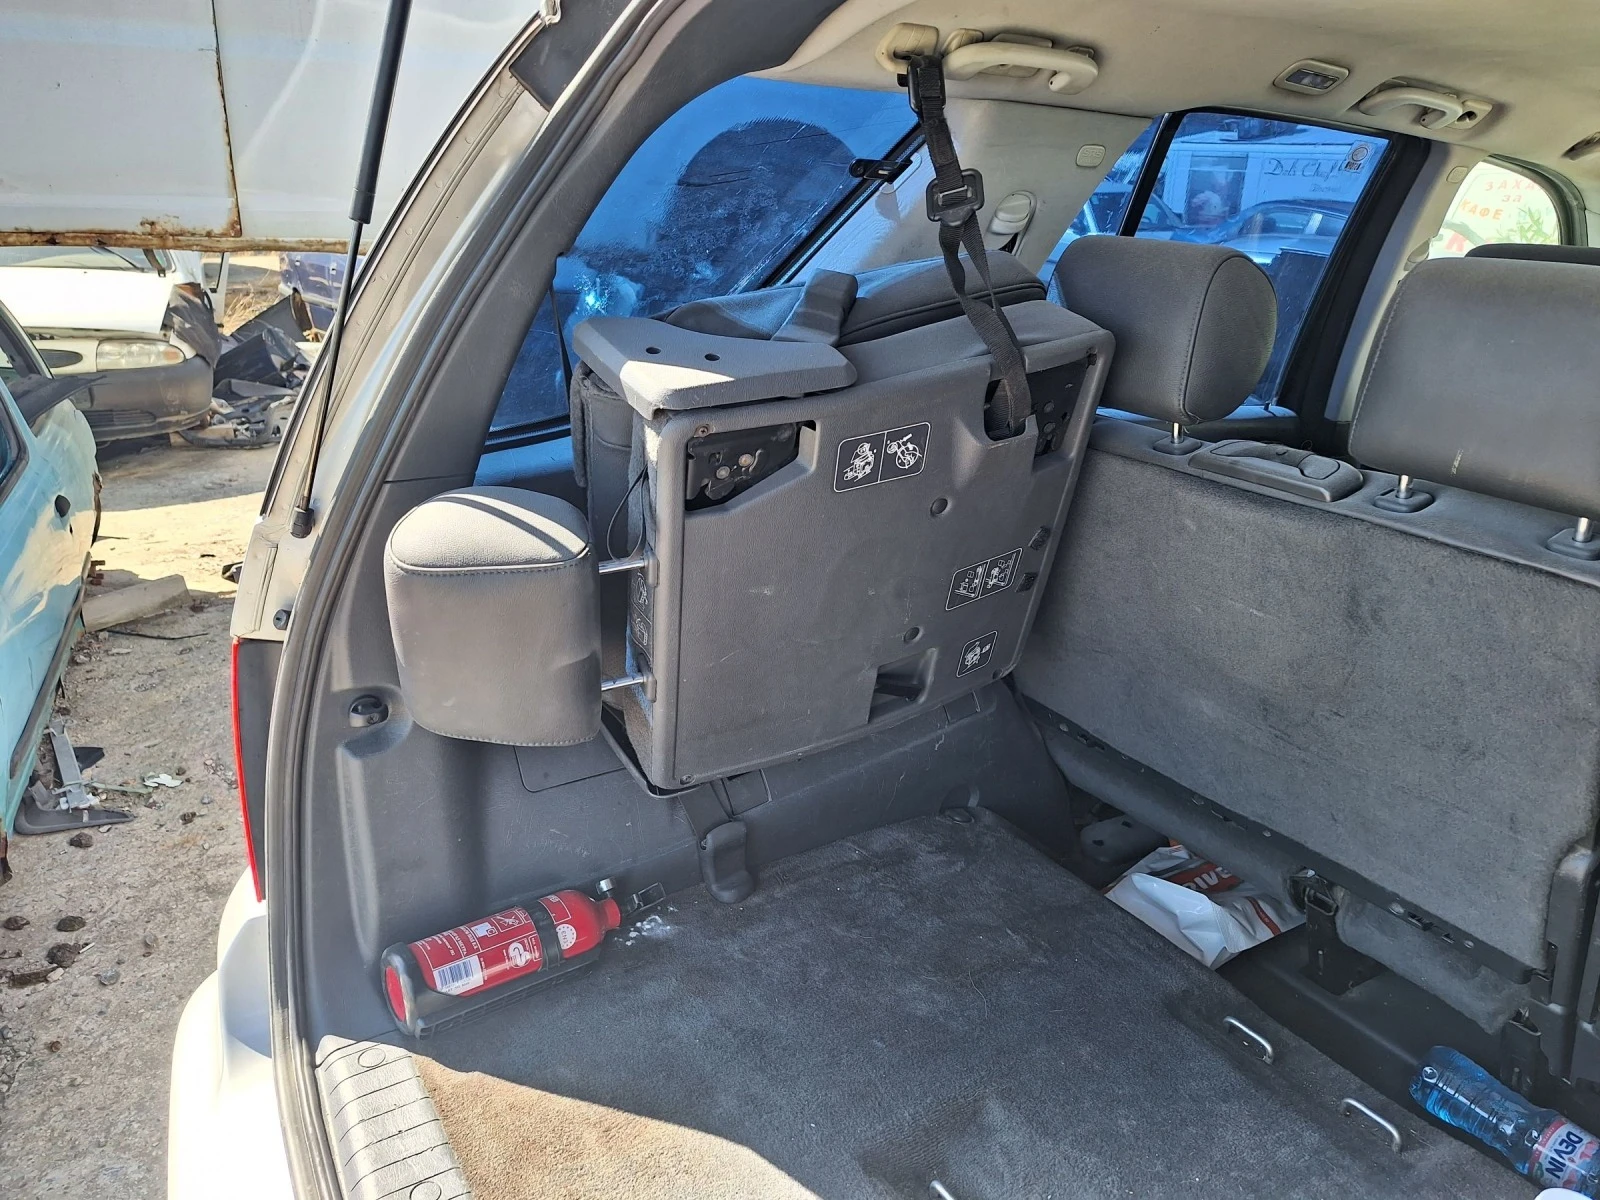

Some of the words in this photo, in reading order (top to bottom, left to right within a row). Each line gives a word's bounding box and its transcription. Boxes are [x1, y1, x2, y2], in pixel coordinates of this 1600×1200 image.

[1484, 178, 1536, 192] ЗАХА
[1459, 198, 1504, 221] КАФЕ
[1545, 1130, 1584, 1179] DEVIN
